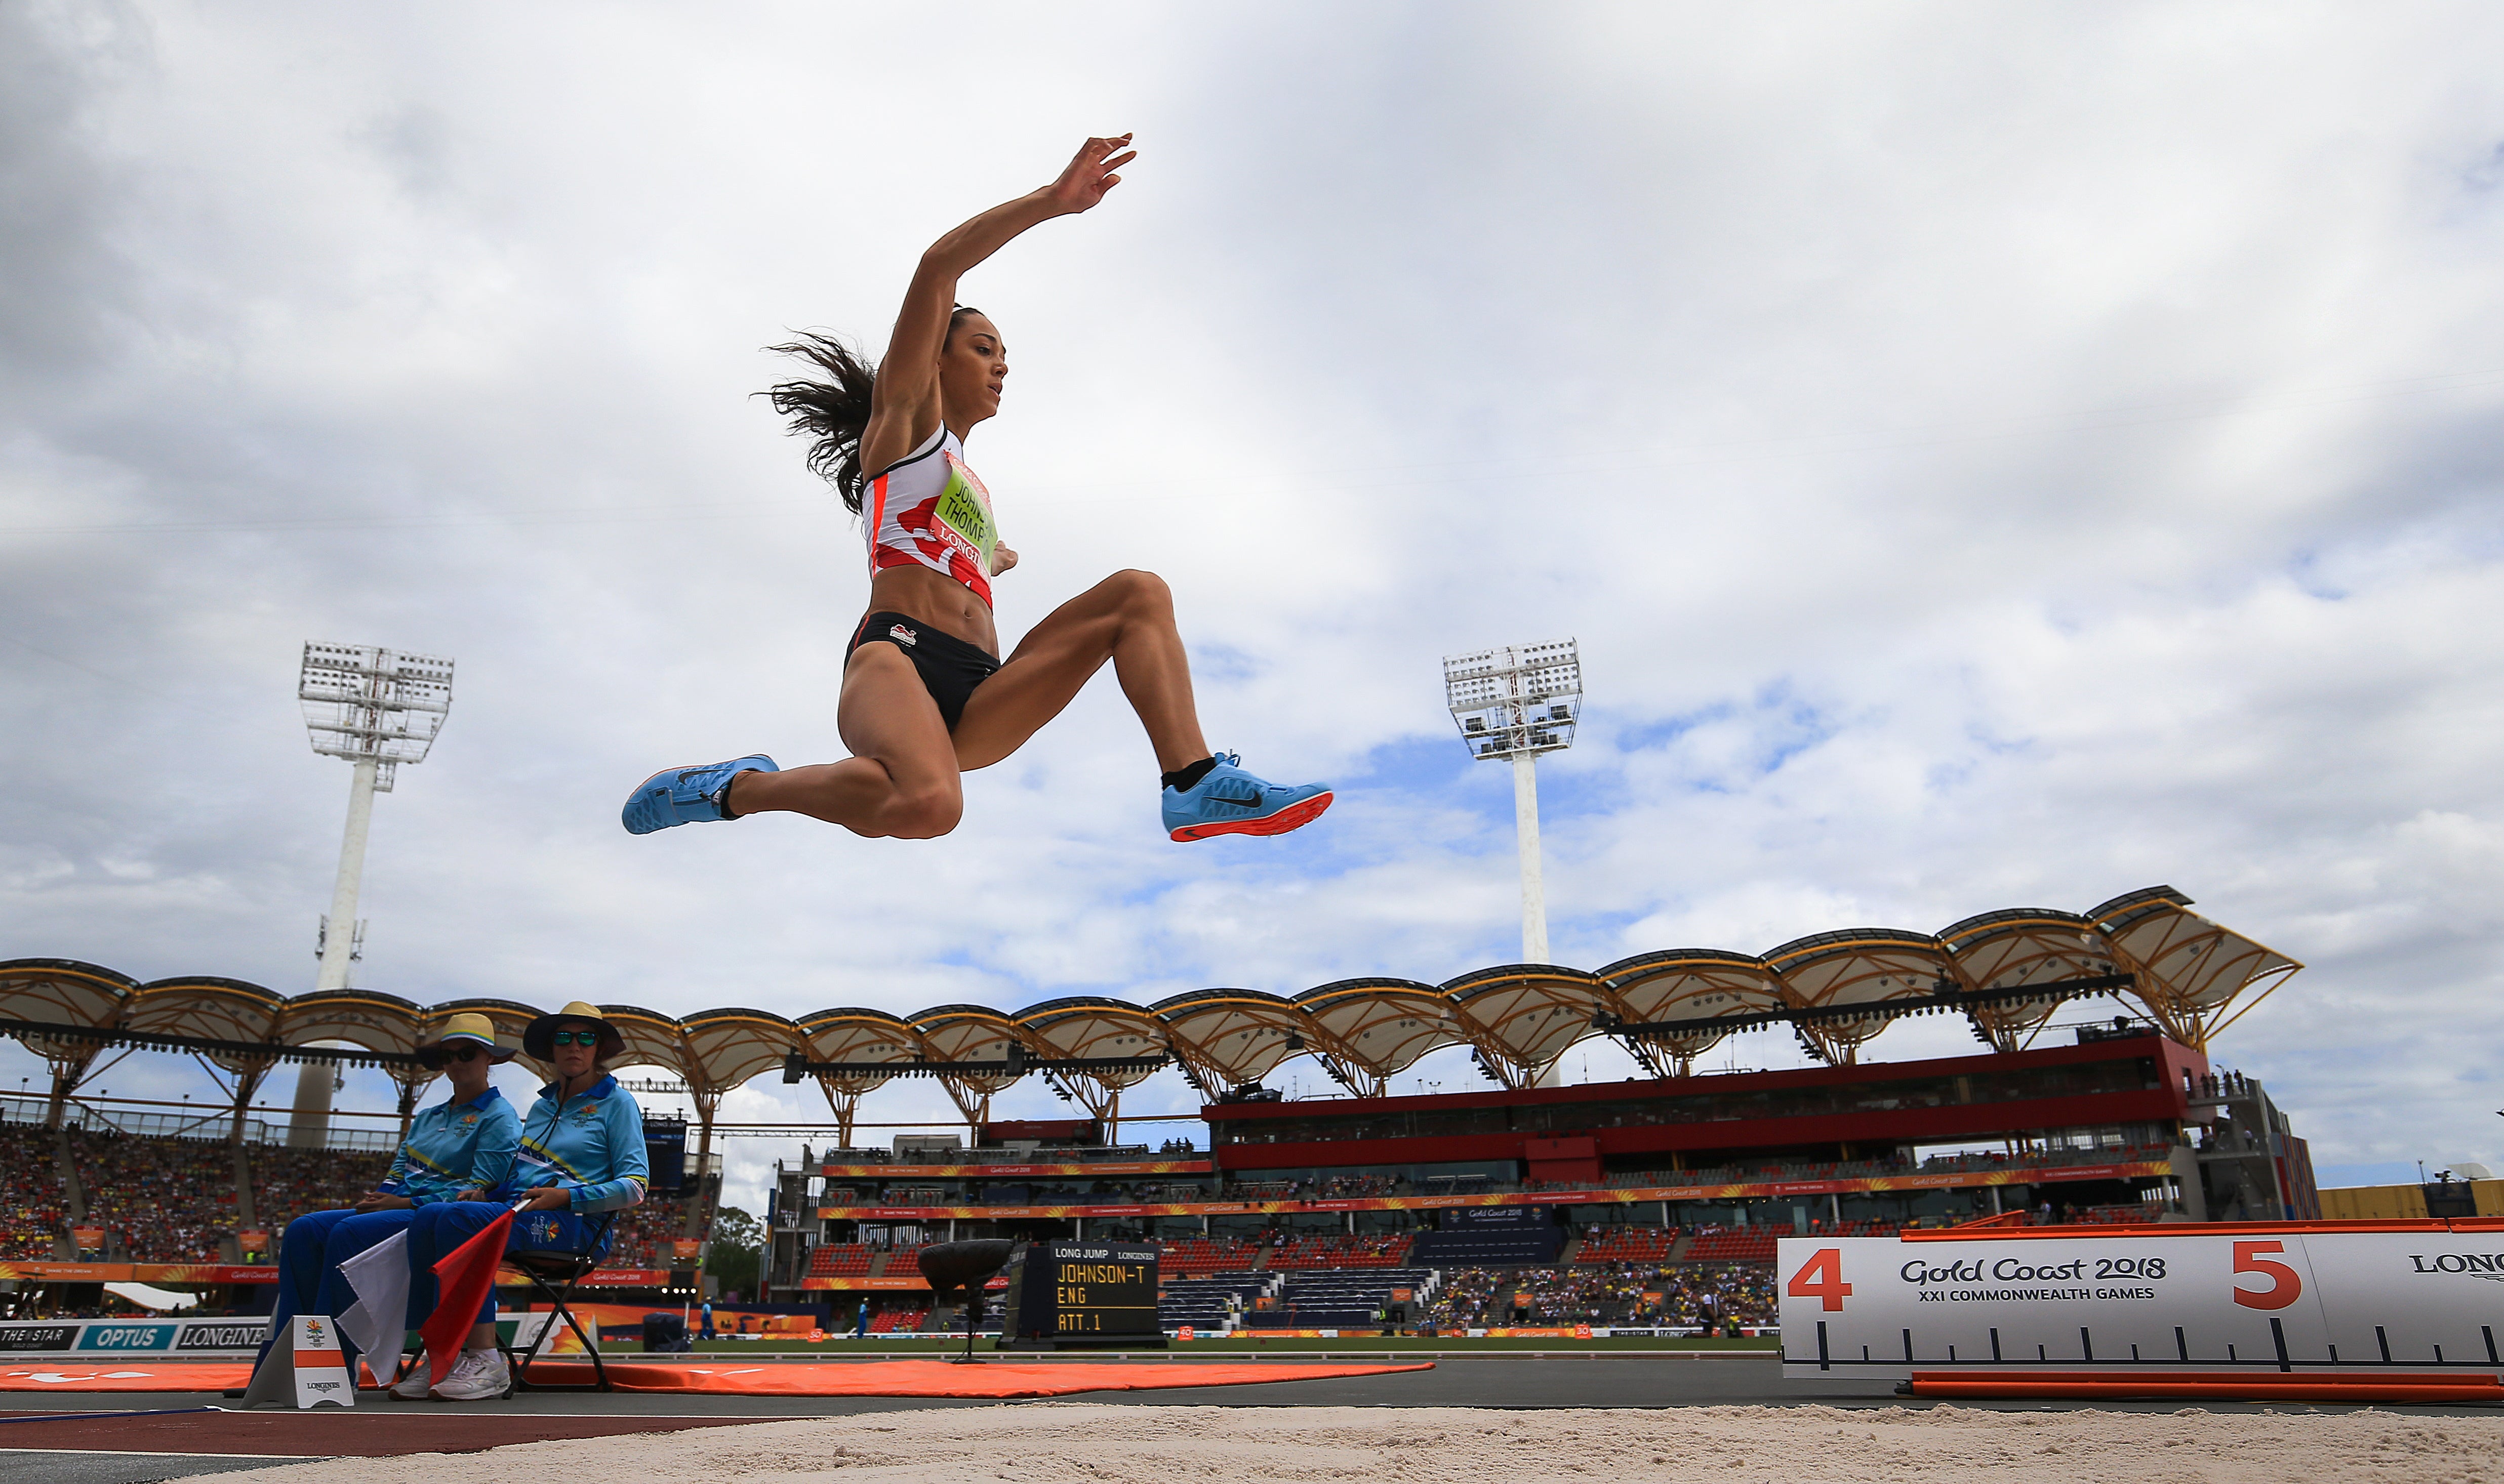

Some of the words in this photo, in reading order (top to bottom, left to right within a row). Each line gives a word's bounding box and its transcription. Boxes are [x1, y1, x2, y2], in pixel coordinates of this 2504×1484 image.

[1469, 1209, 1487, 1217] Gold
[1487, 1209, 1506, 1217] Coast
[1508, 1208, 1522, 1216] 2018
[1056, 1248, 1080, 1258] LONG
[1083, 1249, 1108, 1259] JUMP
[1118, 1252, 1155, 1260] LONGINES
[1058, 1264, 1144, 1284] JOHNSON-T
[1788, 1248, 1852, 1312] 4
[1900, 1259, 1985, 1286] Gold
[1992, 1258, 2087, 1281] Coast
[2095, 1258, 2167, 1280] 2018
[2233, 1240, 2303, 1311] 5
[1058, 1287, 1086, 1304] ENG
[1918, 1290, 1946, 1302] XXI
[1950, 1289, 2091, 1302] COMMONWEALTH
[2095, 1287, 2155, 1300] GAMES
[1, 1330, 27, 1341] THE
[32, 1329, 64, 1341] STAR
[97, 1328, 158, 1347] OPTUS
[180, 1327, 267, 1346] LONGINE
